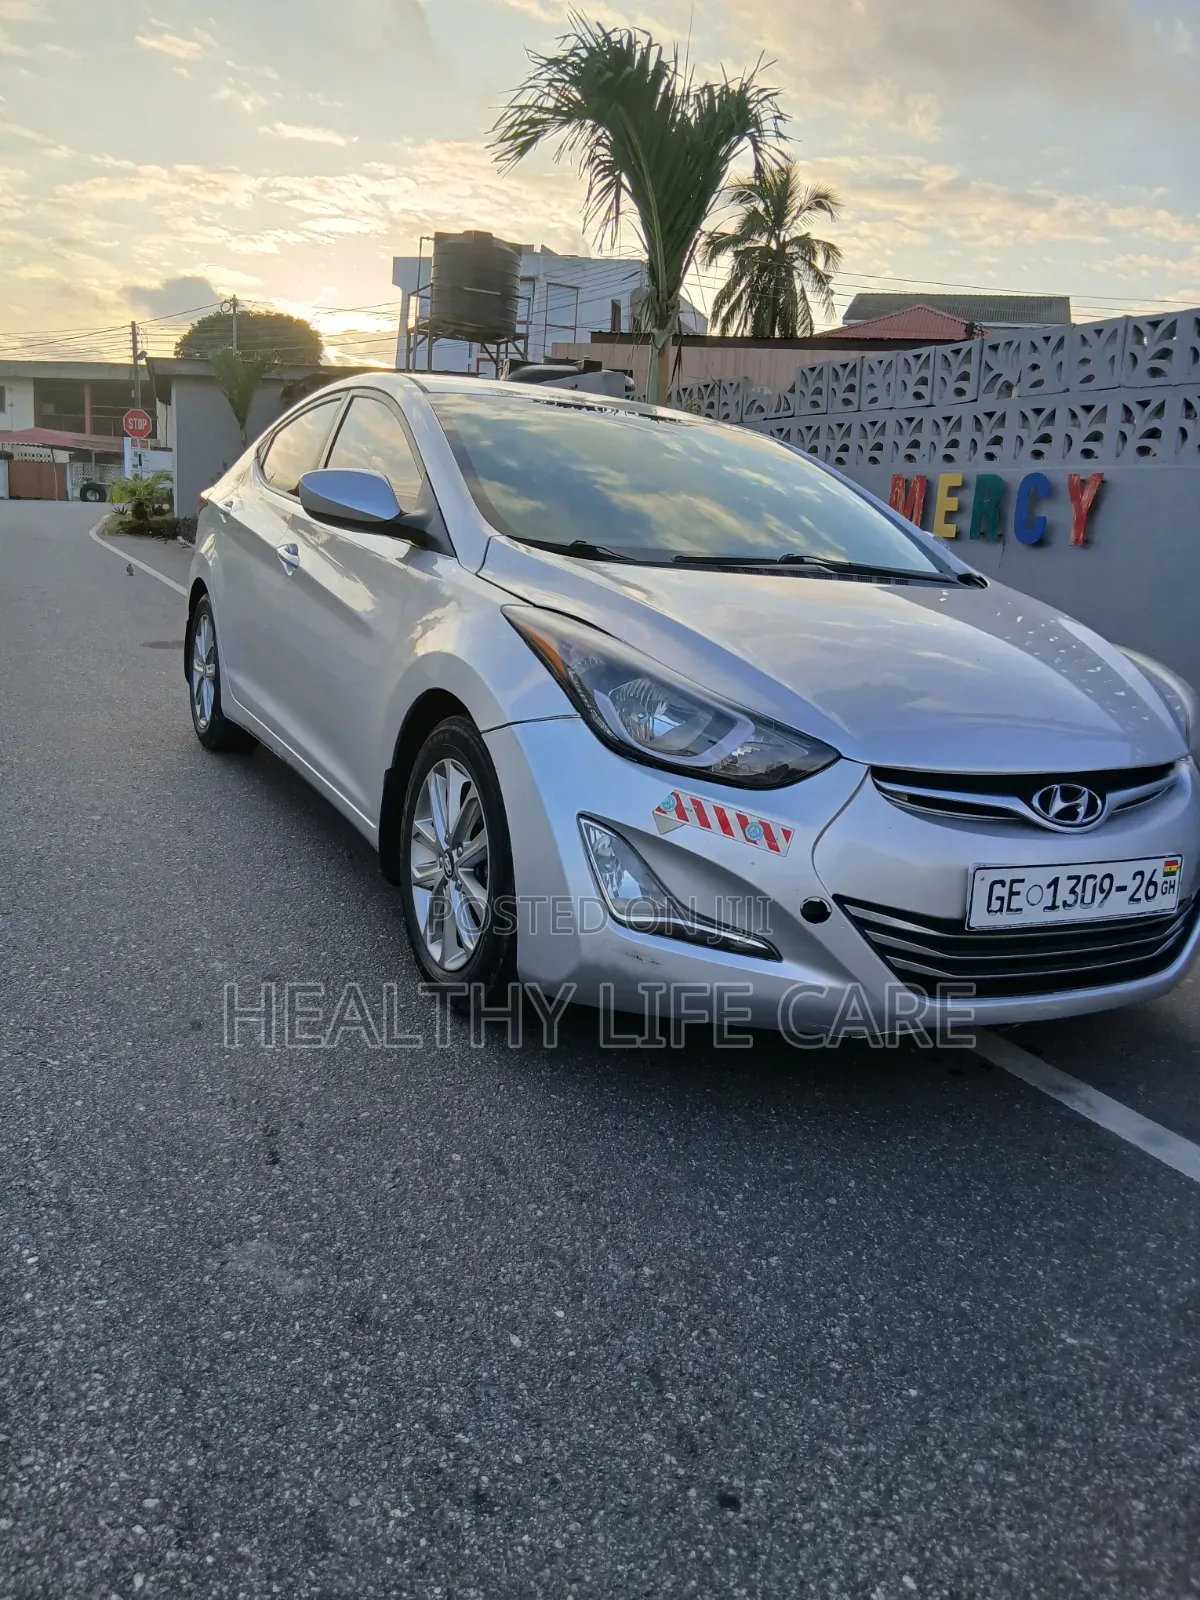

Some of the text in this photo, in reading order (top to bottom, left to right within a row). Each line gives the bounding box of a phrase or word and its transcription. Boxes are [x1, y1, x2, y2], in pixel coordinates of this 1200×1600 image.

[128, 418, 148, 430] STOP
[889, 472, 1104, 546] MERCY
[987, 869, 1158, 915] GE 1309-26
[1161, 879, 1176, 896] GH
